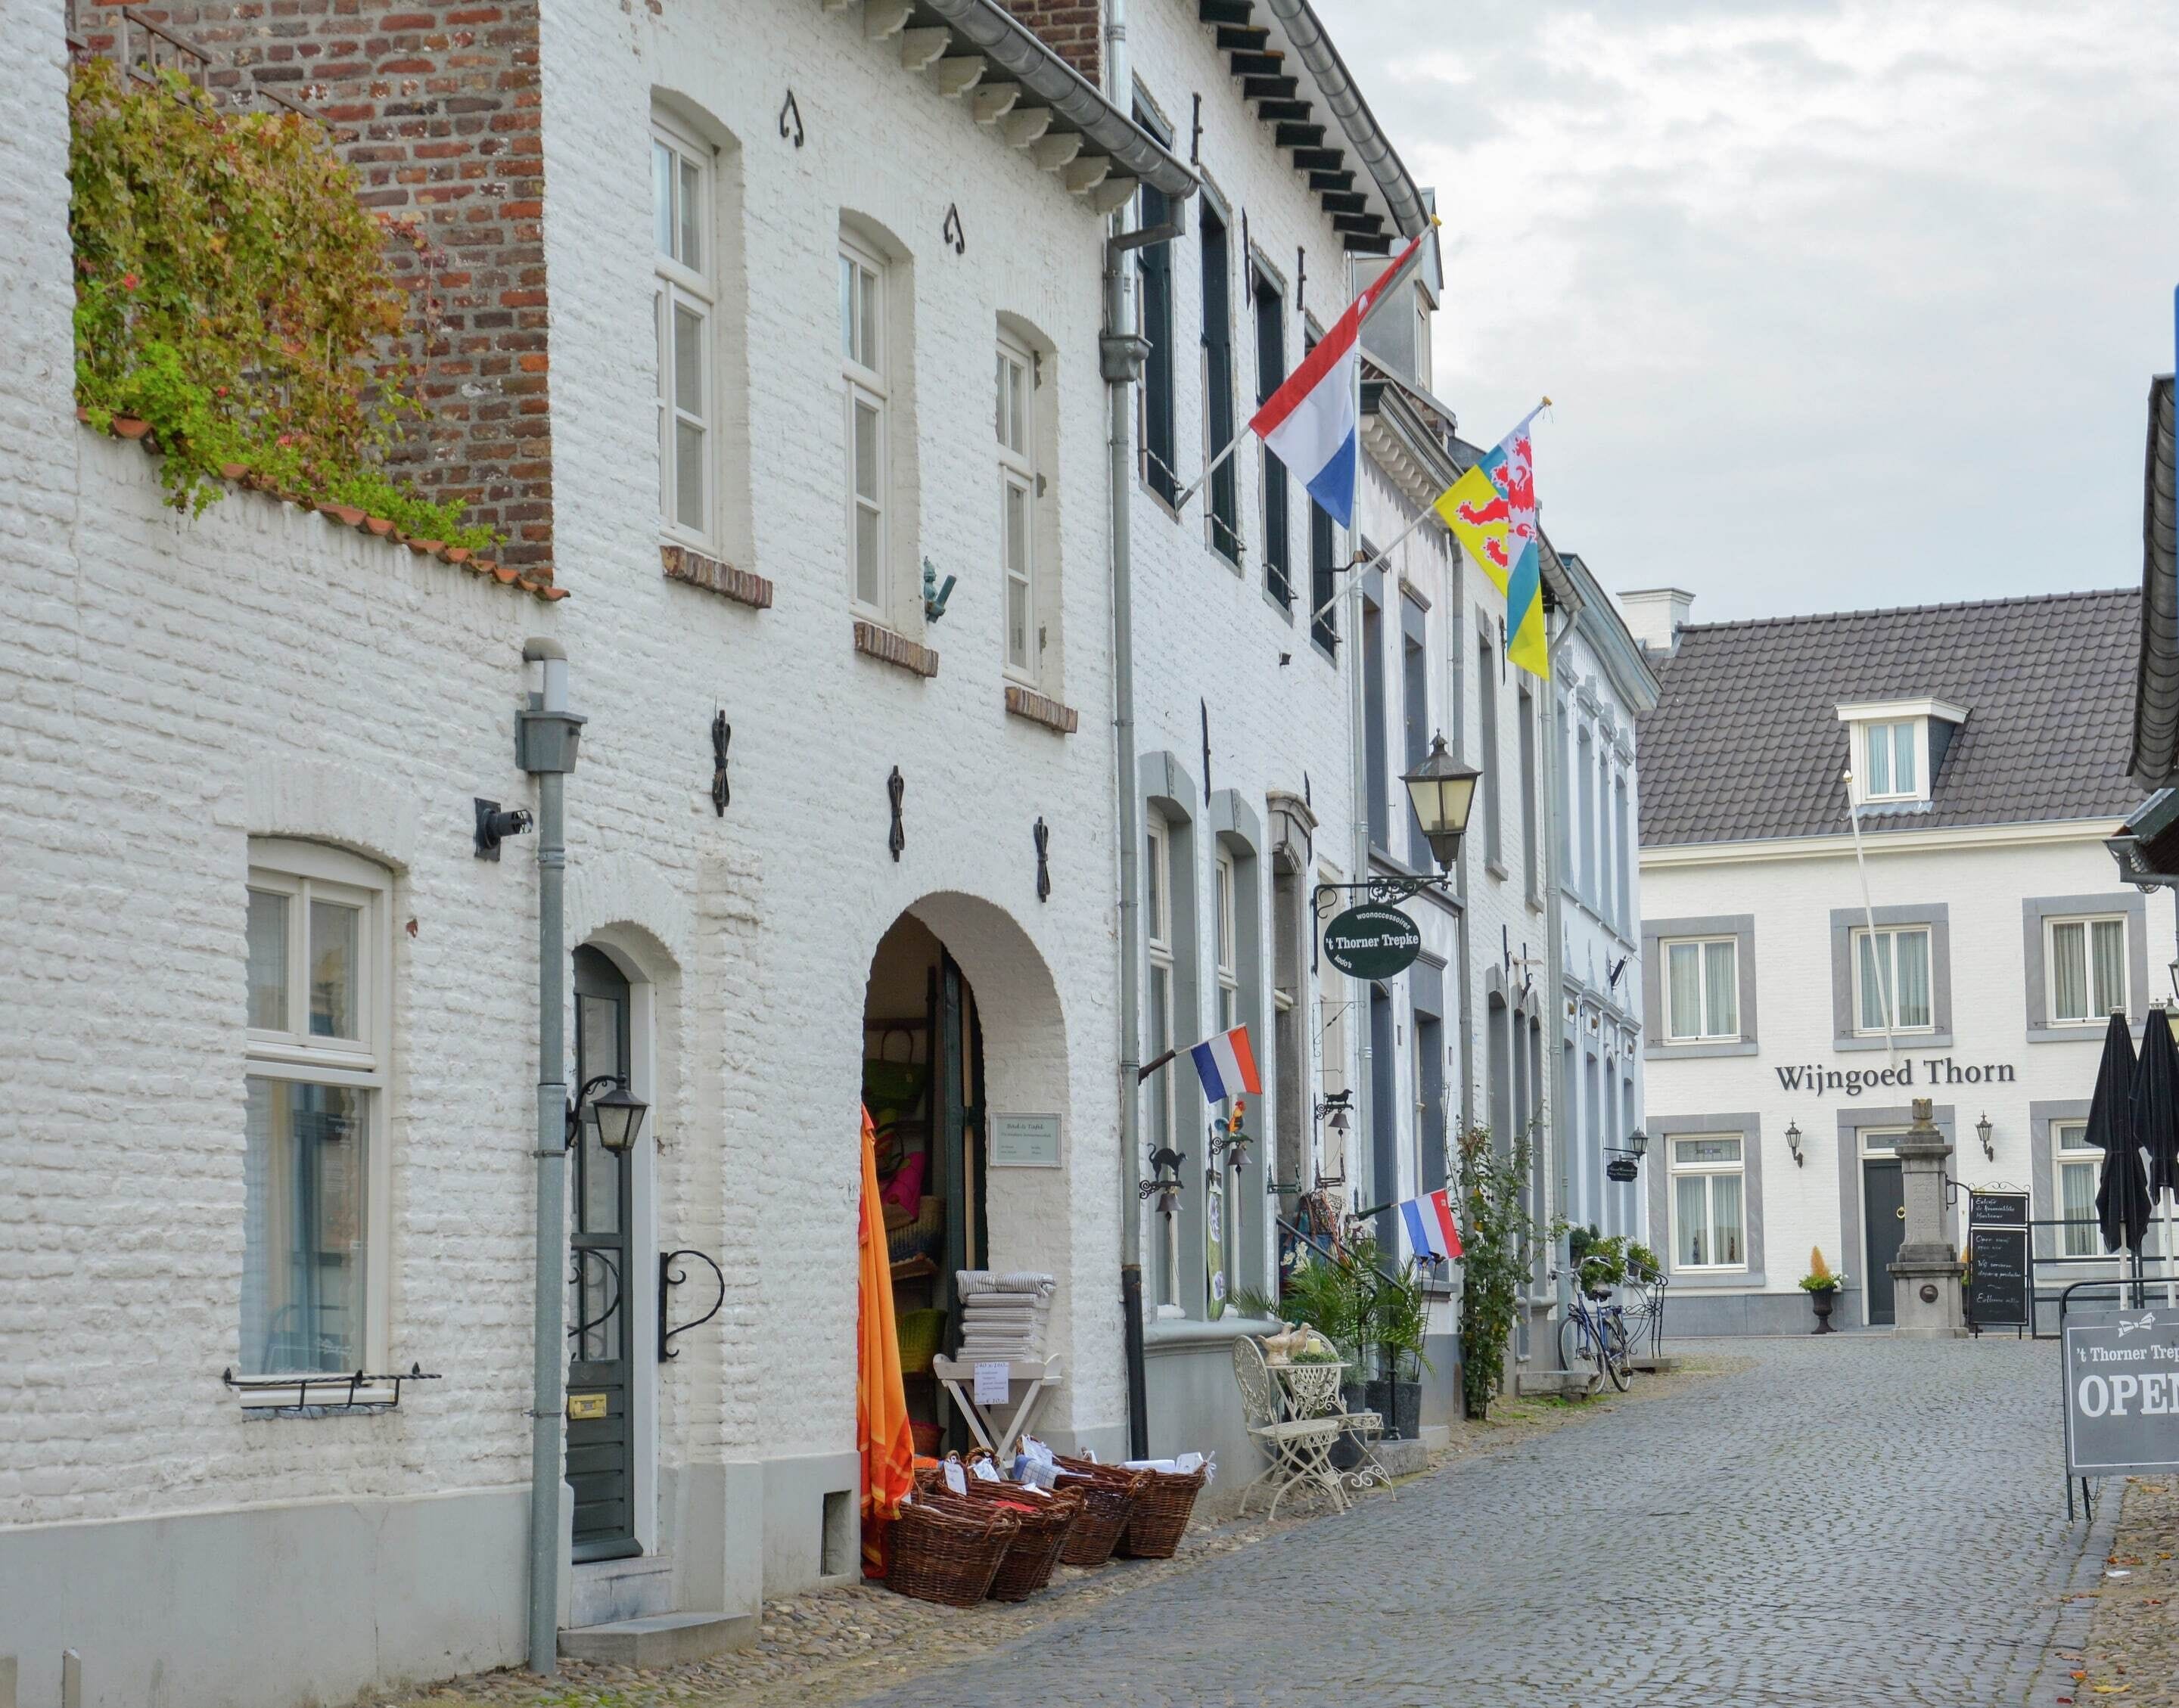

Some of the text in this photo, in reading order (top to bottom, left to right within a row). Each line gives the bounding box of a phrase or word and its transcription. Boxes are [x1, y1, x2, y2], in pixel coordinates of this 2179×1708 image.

[1335, 936, 1379, 949] Thorner
[1382, 933, 1419, 949] Trepke
[1775, 1057, 2016, 1097] Wijngoed Thorn
[2077, 1348, 2087, 1362] 't
[2090, 1347, 2147, 1362] Thorner
